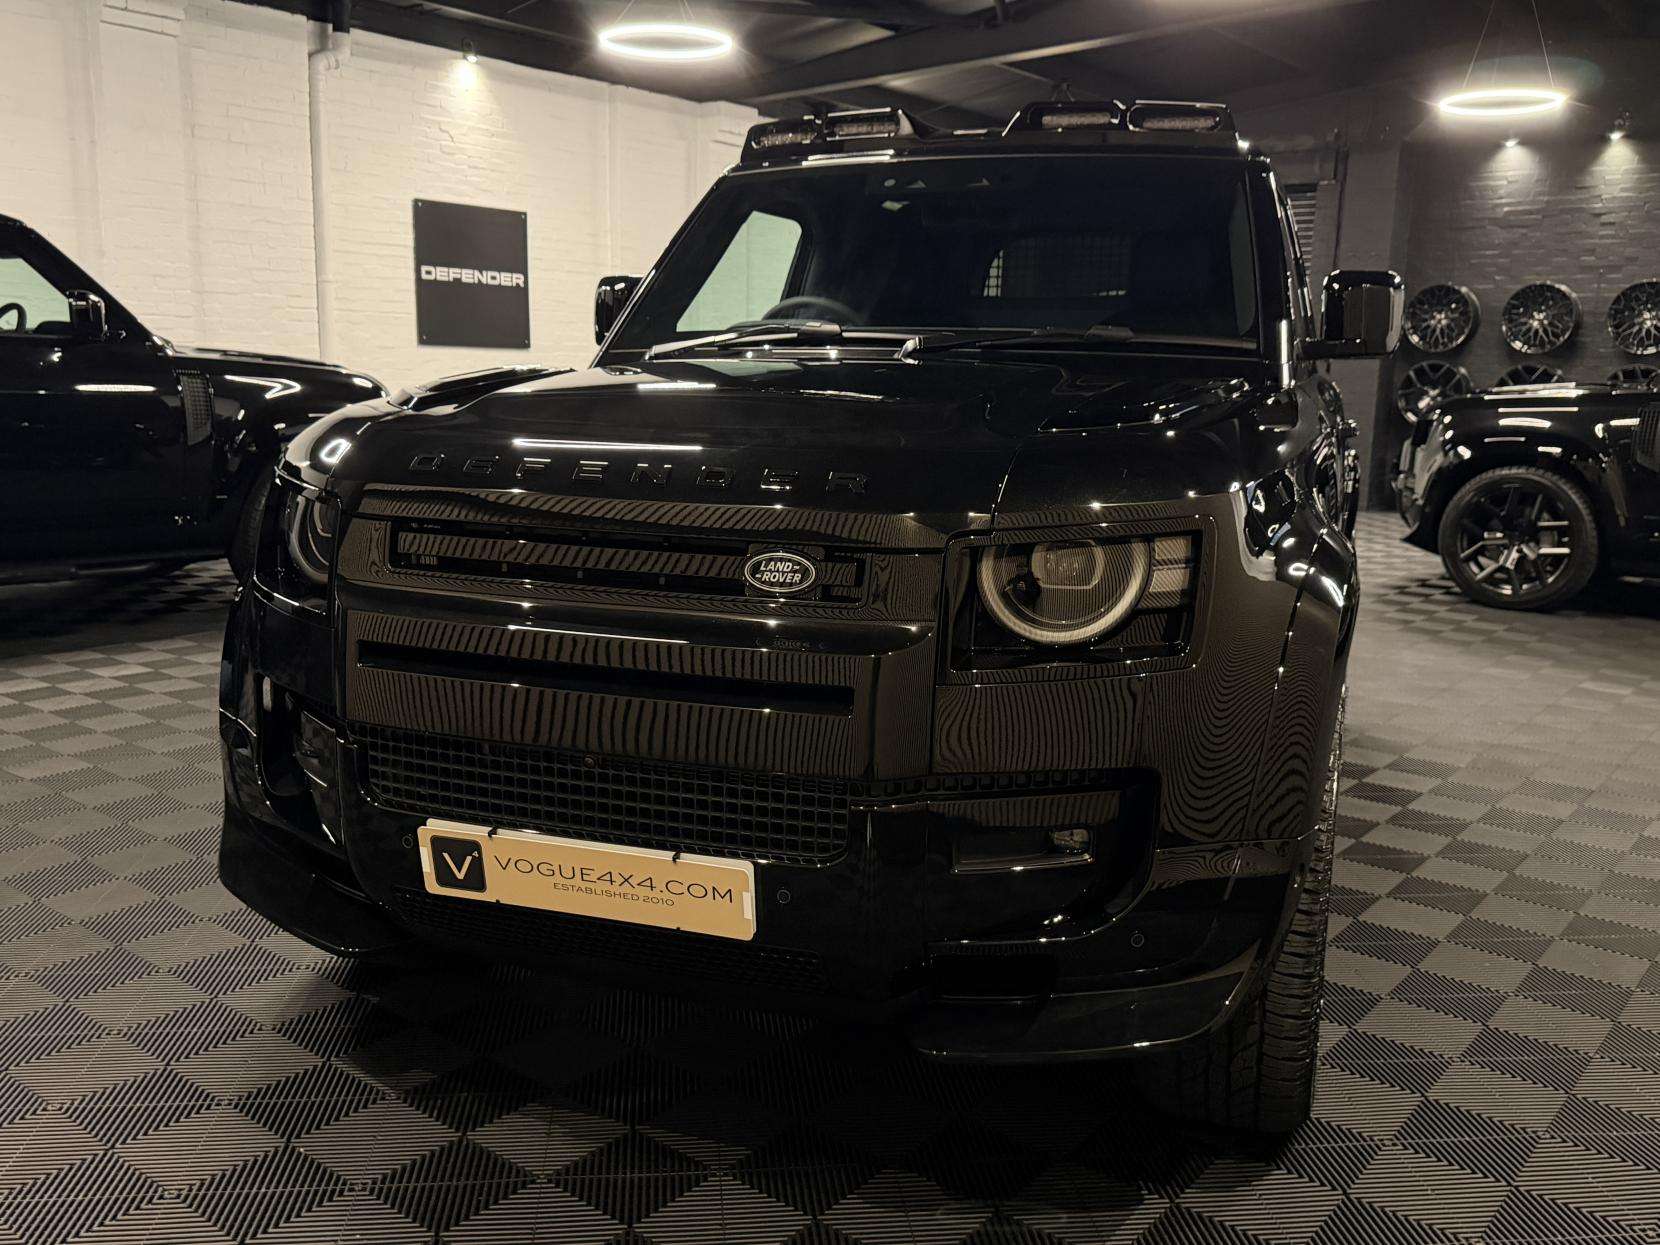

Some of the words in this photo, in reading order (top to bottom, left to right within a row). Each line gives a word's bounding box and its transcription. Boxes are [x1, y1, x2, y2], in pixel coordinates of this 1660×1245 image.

[420, 264, 525, 288] DEFENDER
[407, 453, 871, 496] DEFENDER
[493, 854, 734, 904] VOGUE4X4.COM
[553, 881, 640, 902] ESTABLISHED
[642, 894, 676, 907] 2010
